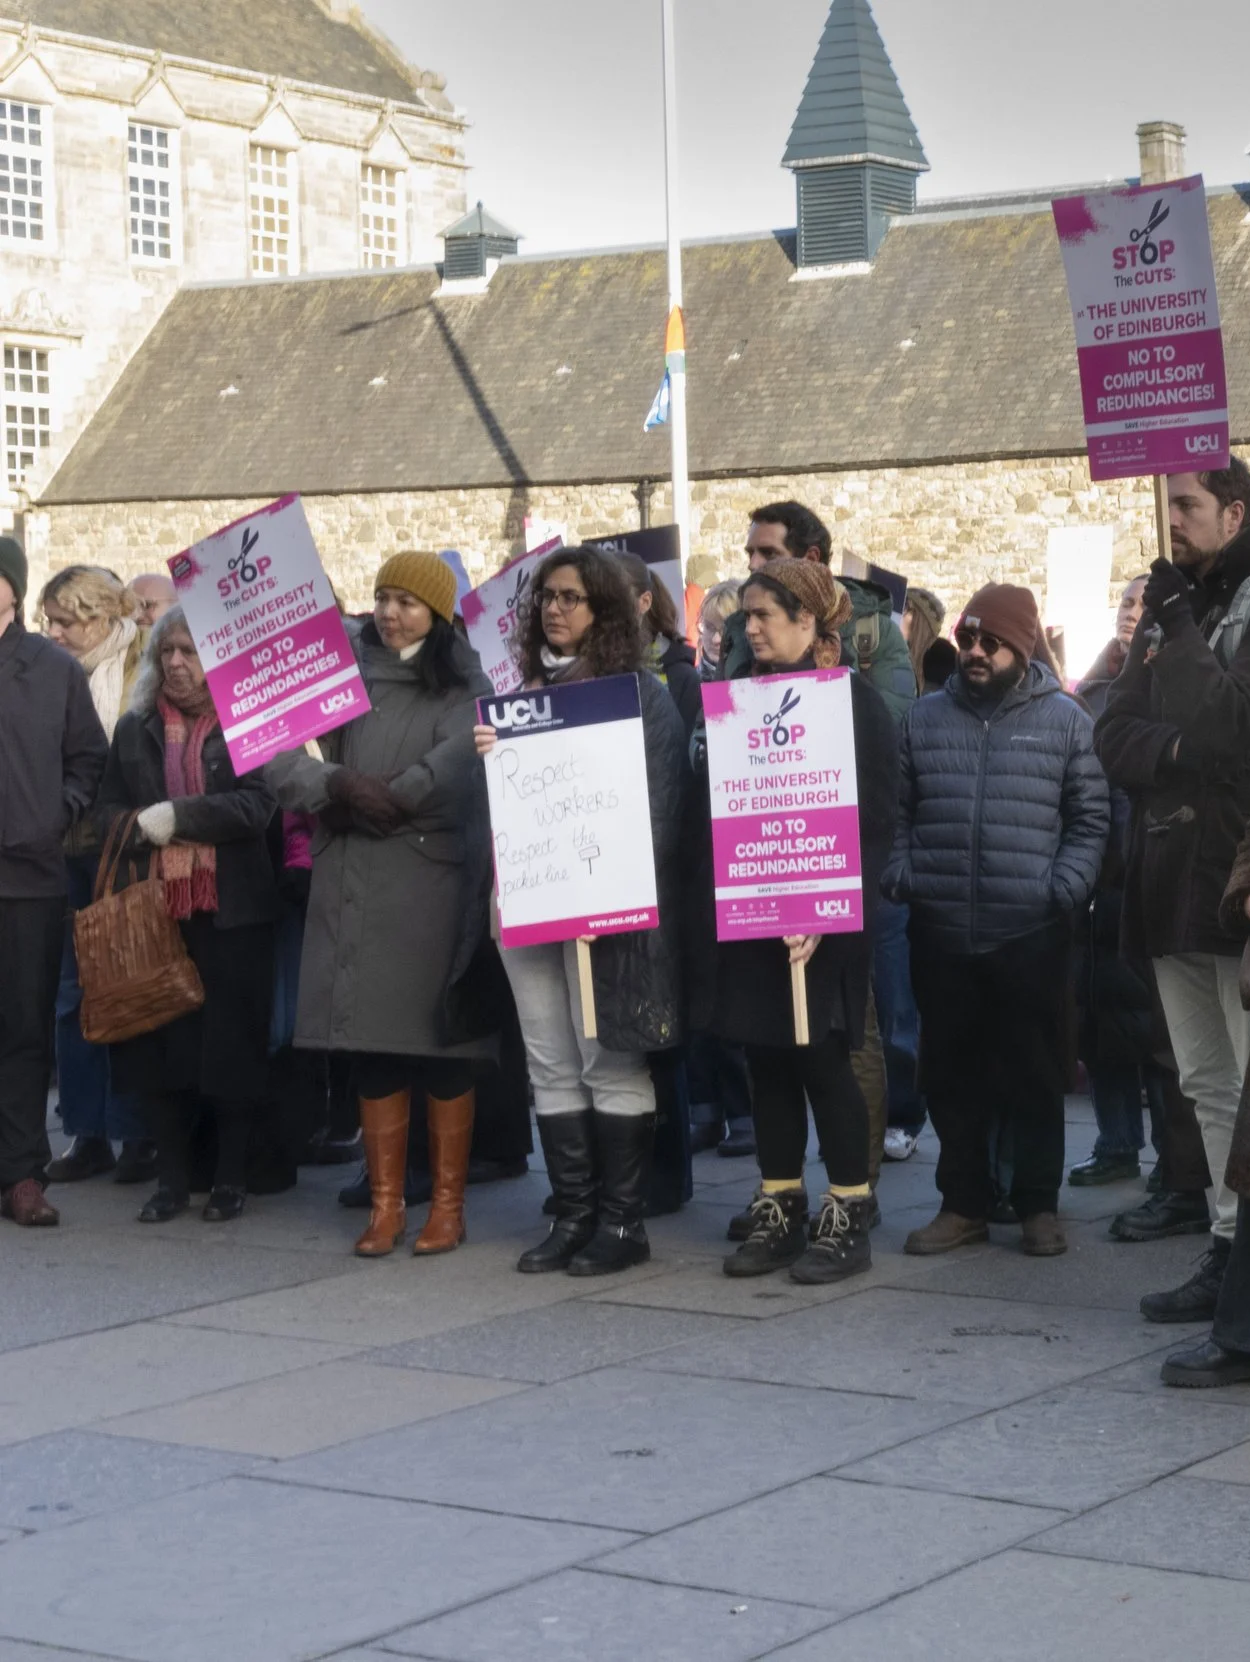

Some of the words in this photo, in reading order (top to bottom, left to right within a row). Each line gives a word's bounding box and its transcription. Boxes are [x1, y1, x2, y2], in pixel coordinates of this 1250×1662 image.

[1112, 239, 1175, 270] STOP
[1114, 275, 1133, 288] The
[1134, 267, 1176, 286] CUTS:
[1087, 302, 1117, 320] THE
[1120, 288, 1207, 316] UNIVERSITY
[1093, 323, 1114, 341] OF
[1118, 311, 1206, 337] EDINBURGH
[1128, 348, 1150, 366] NO
[1153, 345, 1175, 363] TO
[1103, 363, 1205, 391] COMPULSORY
[1096, 383, 1215, 413] REDUNDANCIES!
[217, 555, 272, 598] STOP
[223, 598, 241, 612] The
[240, 576, 279, 603] CUTS:
[206, 624, 233, 647] THE
[235, 579, 315, 631] UNIVERSITY
[216, 641, 235, 660] OF
[237, 600, 318, 650] EDINBURGH
[251, 648, 272, 669] NO
[273, 636, 294, 655] TO
[233, 638, 326, 698] COMPULSORY
[488, 660, 509, 680] THE
[230, 651, 340, 718] REDUNDANCIES!
[496, 676, 509, 693] OF
[747, 724, 806, 749] STOP
[748, 754, 766, 766] The
[767, 749, 807, 764] CUTS:
[494, 748, 584, 802] Respect
[722, 778, 750, 793] THE
[754, 768, 842, 790] UNIVERSITY
[728, 797, 748, 812] OF
[751, 789, 839, 810] EDINBURGH
[761, 820, 782, 837] NO
[785, 818, 807, 834] TO
[495, 832, 558, 869] Respect
[573, 824, 596, 849] the
[735, 835, 837, 858] COMPULSORY
[728, 853, 847, 878] REDUNDANCIES!
[502, 872, 540, 908] picket
[544, 864, 570, 883] line
[588, 911, 650, 929] www.ucu.org.uk
